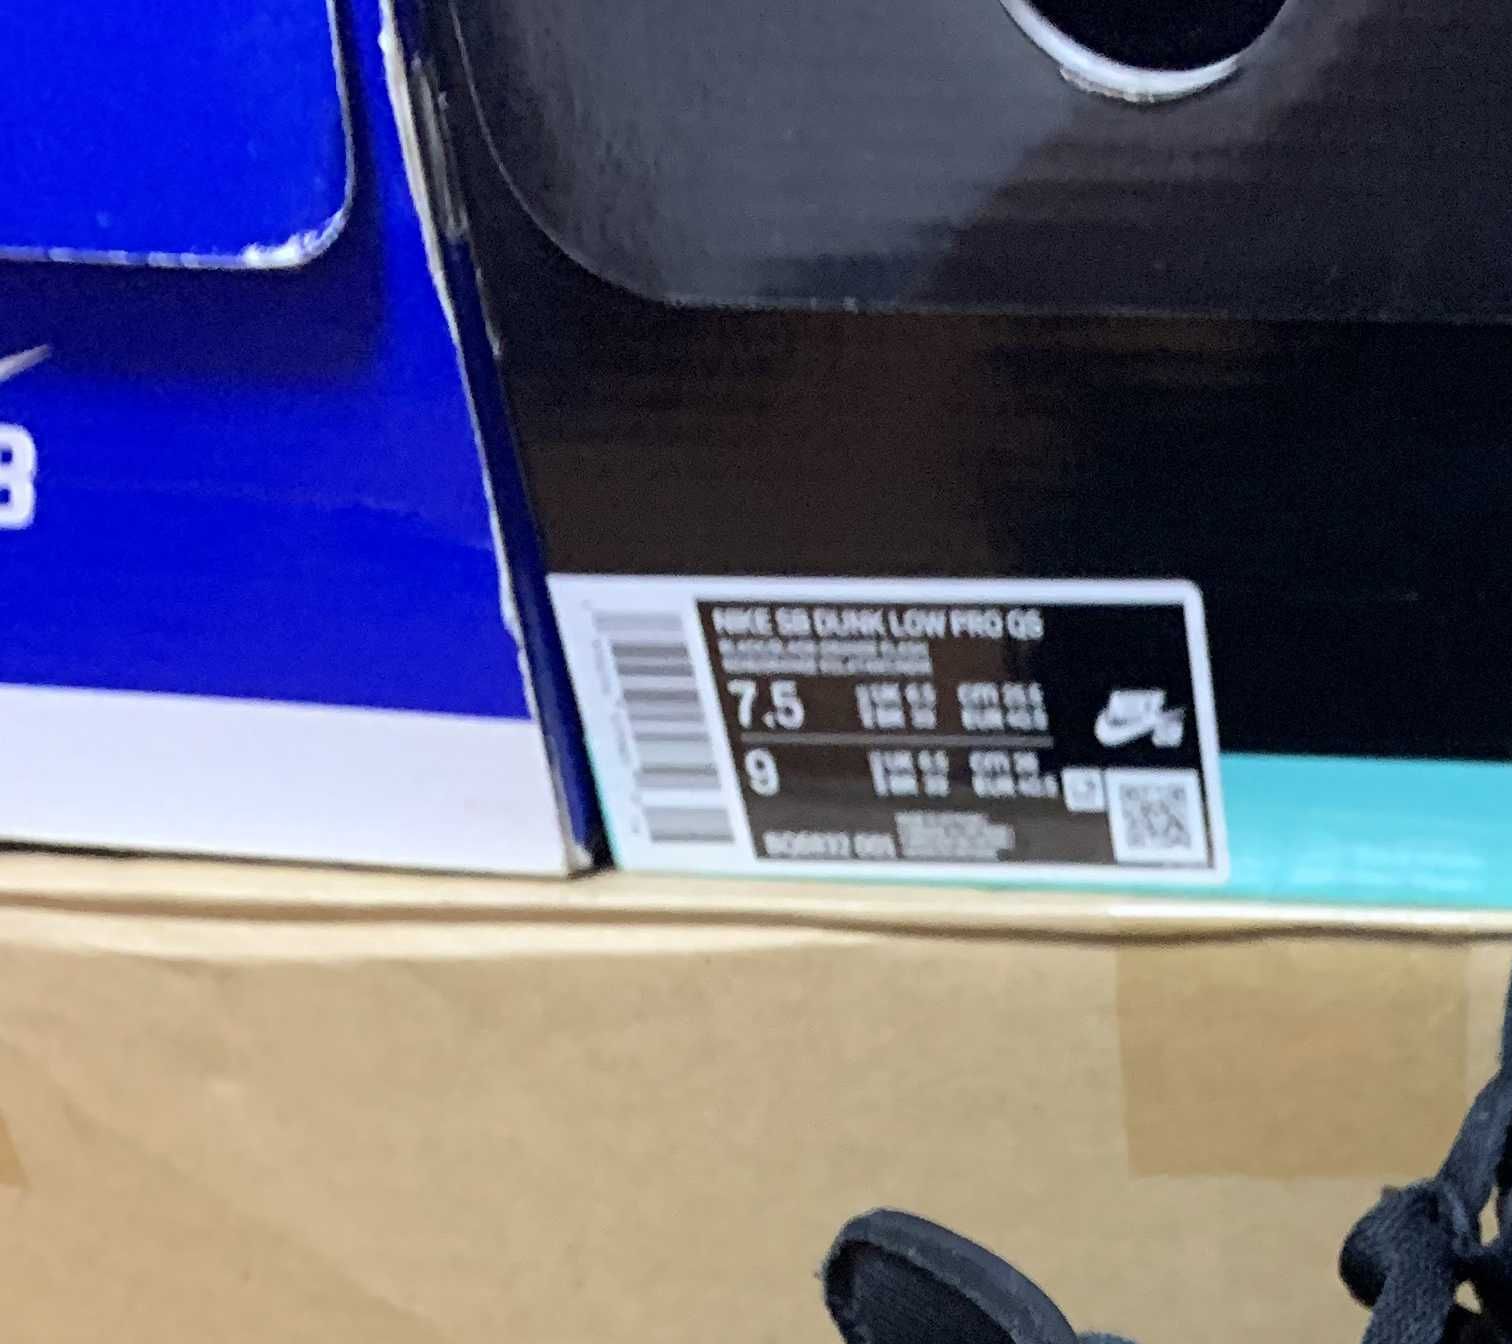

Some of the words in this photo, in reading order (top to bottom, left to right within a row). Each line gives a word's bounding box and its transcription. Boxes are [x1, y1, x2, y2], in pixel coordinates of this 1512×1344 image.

[711, 606, 772, 636] NIKE
[775, 606, 811, 637] SB
[812, 606, 885, 638] DUNK
[887, 607, 946, 639] LOW
[949, 607, 1004, 640] PRO
[726, 678, 805, 730] 7.5
[744, 746, 780, 798] 9
